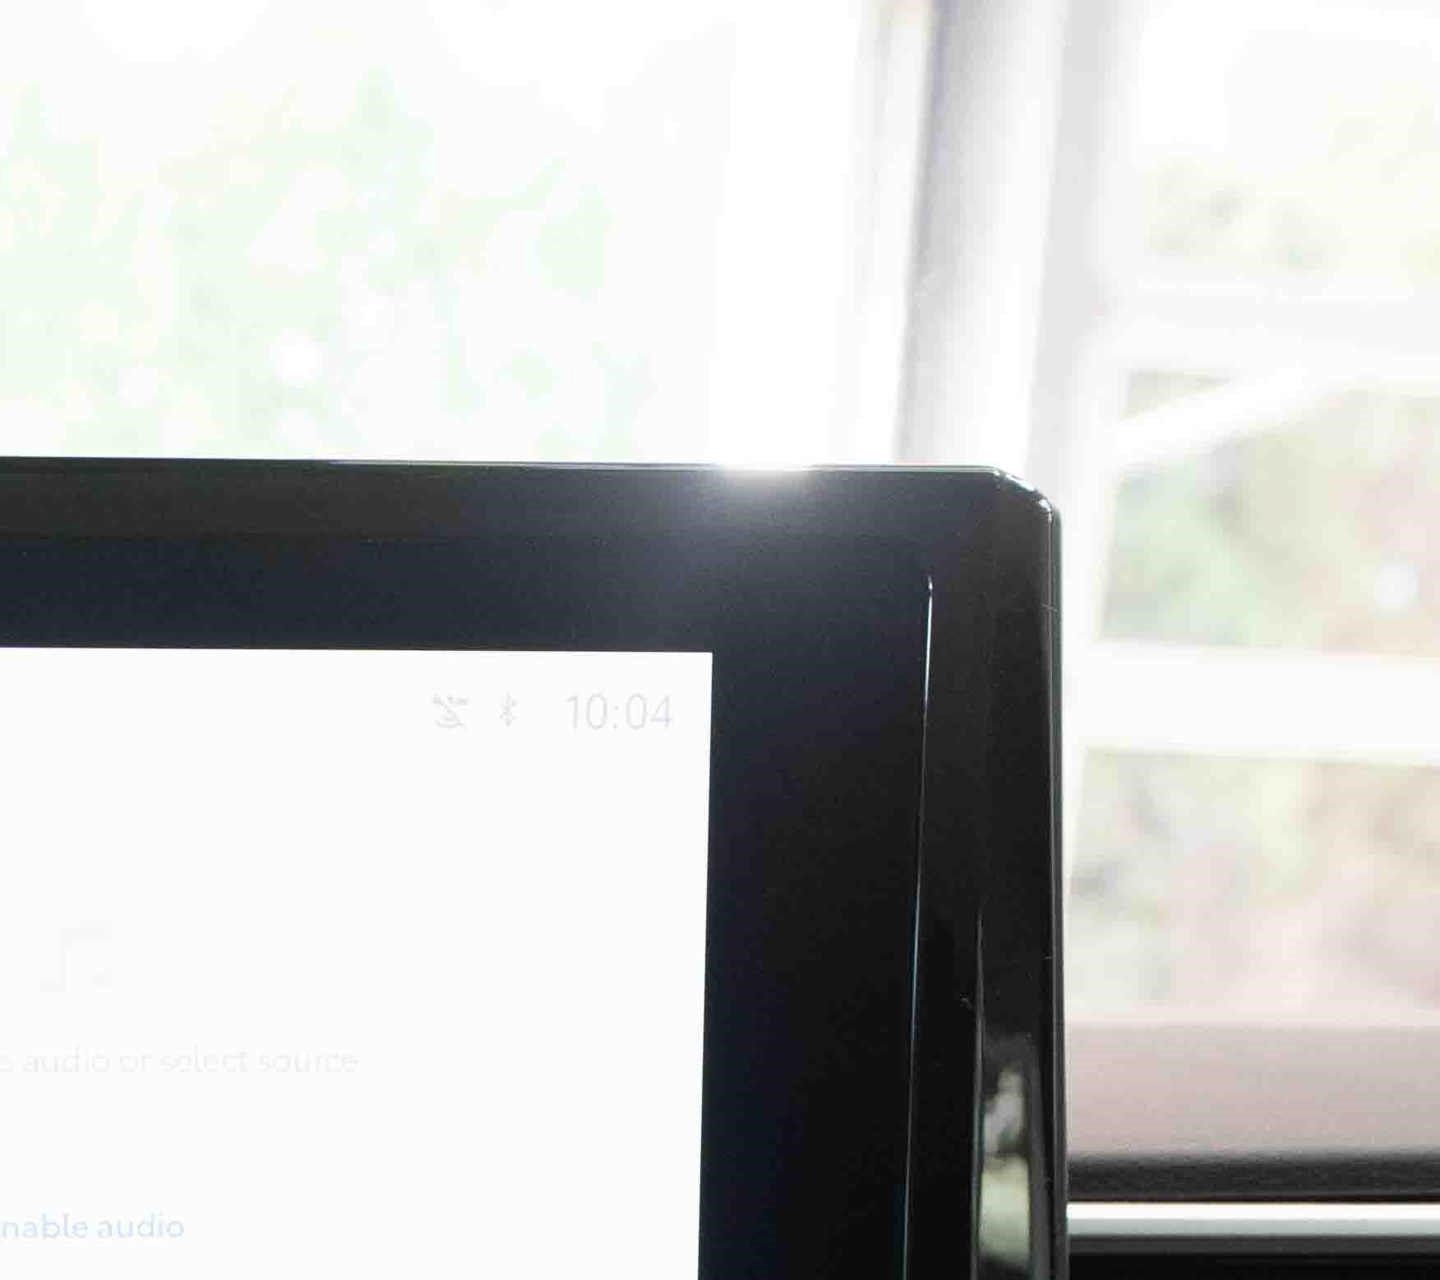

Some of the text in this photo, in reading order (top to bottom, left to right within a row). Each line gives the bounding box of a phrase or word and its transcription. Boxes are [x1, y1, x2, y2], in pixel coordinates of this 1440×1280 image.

[565, 691, 673, 730] 10:04
[22, 1042, 111, 1074] audio
[120, 1048, 152, 1074] or
[160, 1042, 249, 1074] select
[257, 1046, 360, 1074] source
[96, 1209, 185, 1241] audio
